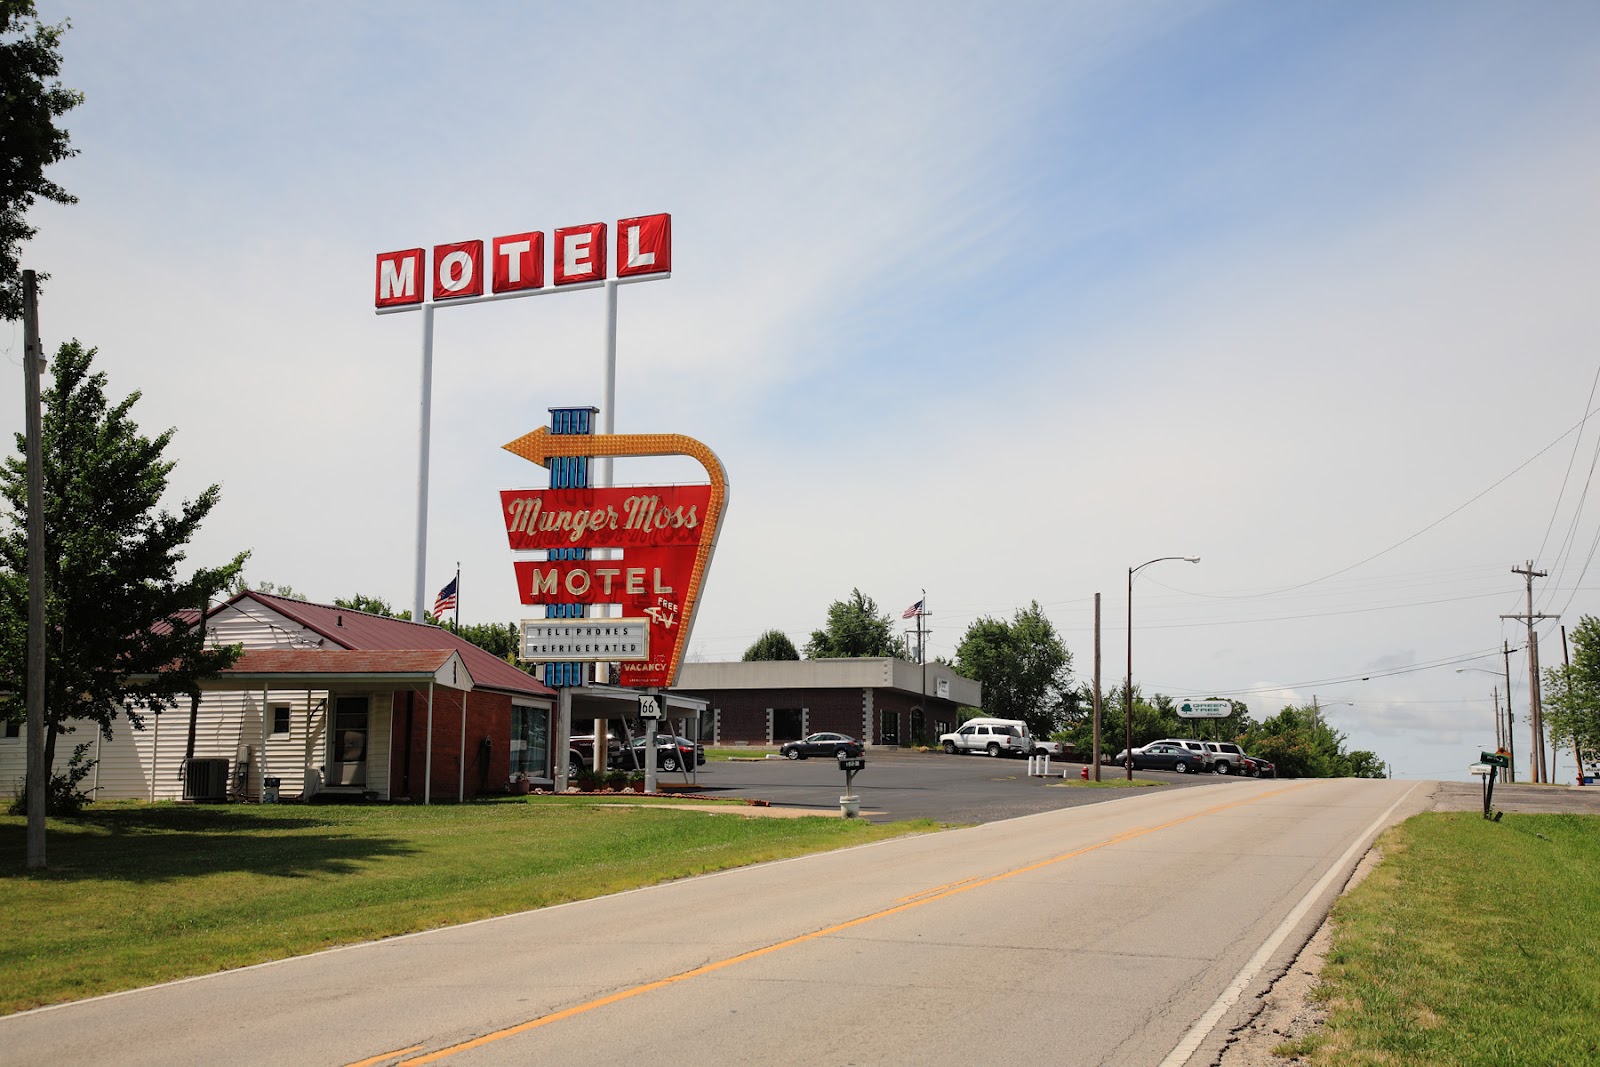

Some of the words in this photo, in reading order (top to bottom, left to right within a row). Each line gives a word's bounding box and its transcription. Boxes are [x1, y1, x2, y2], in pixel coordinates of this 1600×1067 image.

[380, 225, 655, 300] MOTEL
[508, 497, 619, 542] Munger
[623, 495, 699, 533] Moss
[531, 567, 673, 595] MOTEL
[657, 596, 679, 613] FREE
[537, 627, 629, 636] TELEPHONES
[532, 644, 636, 652] REFRIGERATED
[622, 663, 667, 671] VACANCY
[642, 700, 654, 714] 66
